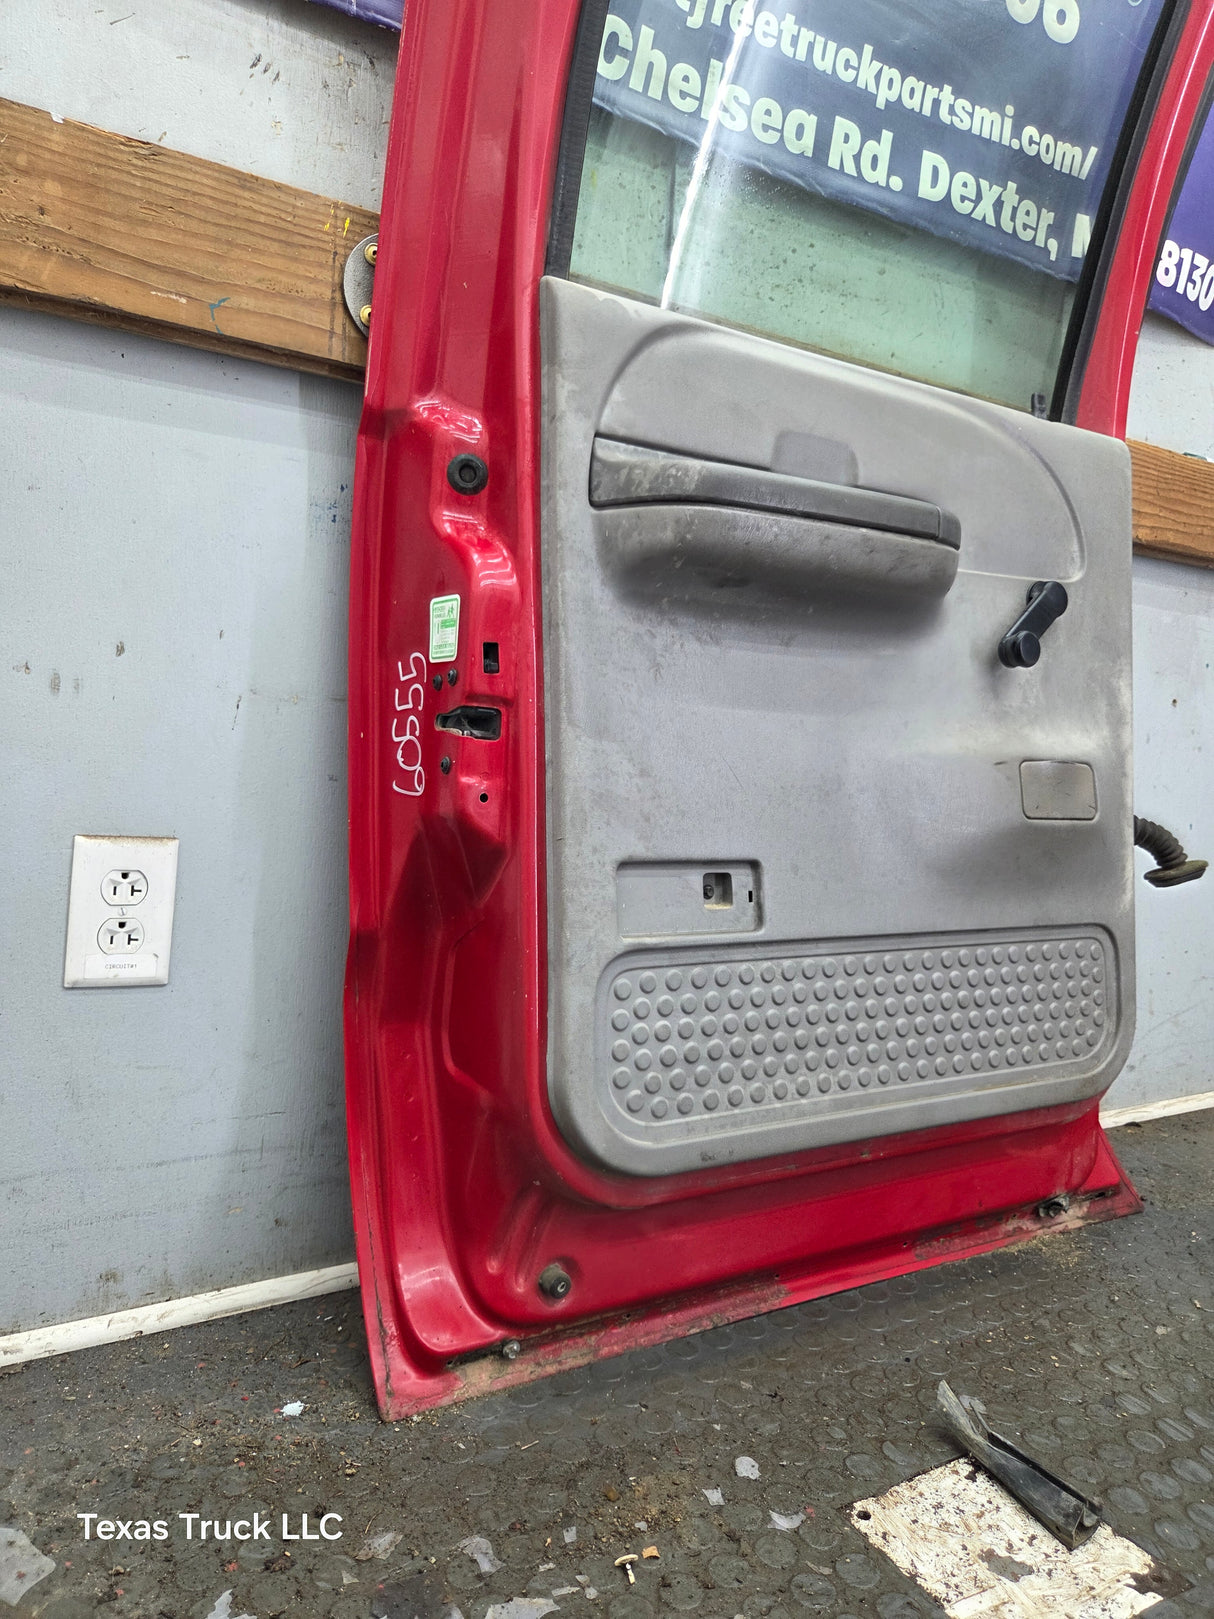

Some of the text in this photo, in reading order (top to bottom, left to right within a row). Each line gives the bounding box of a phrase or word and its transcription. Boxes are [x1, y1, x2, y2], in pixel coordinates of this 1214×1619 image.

[597, 14, 817, 156] Chelsea
[828, 116, 903, 192] Rd.
[918, 150, 1058, 261] Dexter,
[391, 651, 427, 796] 60555
